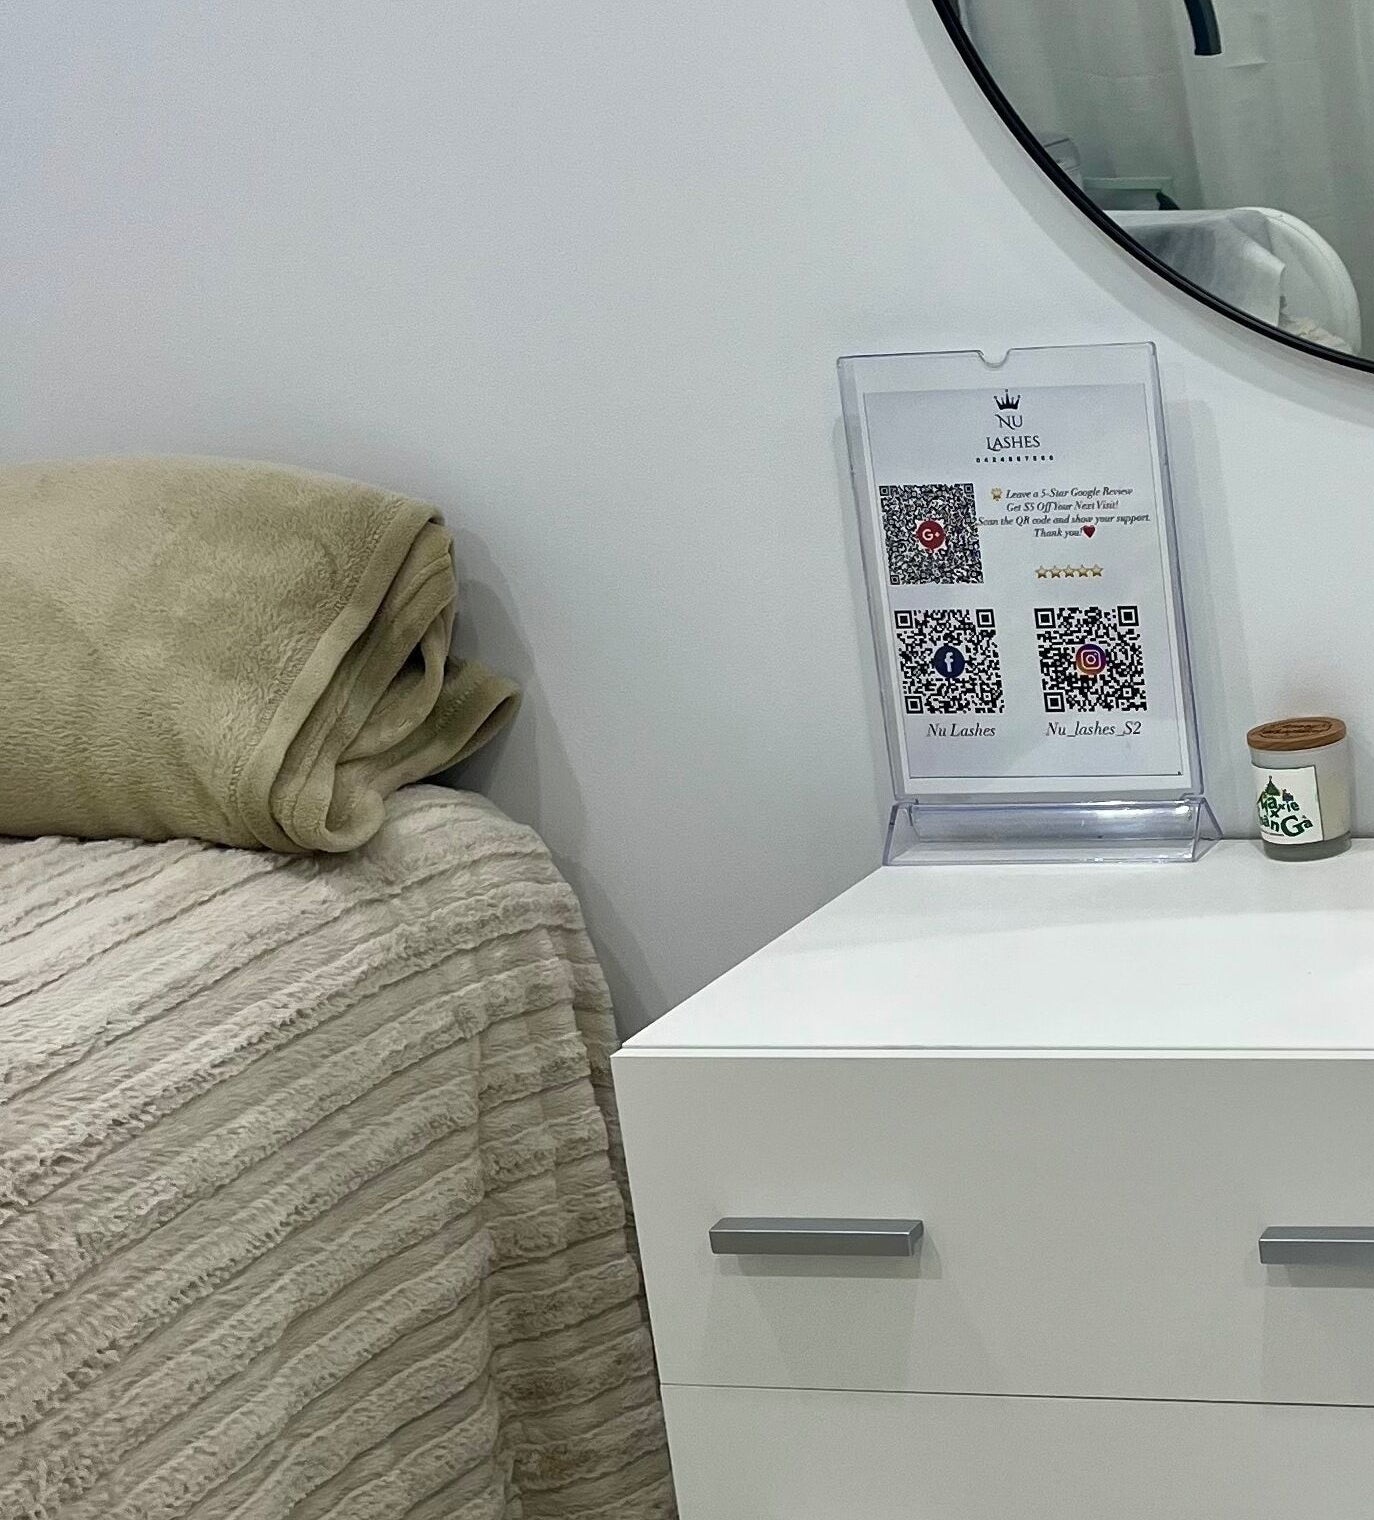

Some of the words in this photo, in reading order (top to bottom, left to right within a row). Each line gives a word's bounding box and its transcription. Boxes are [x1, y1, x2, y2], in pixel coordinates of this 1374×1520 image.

[994, 414, 1023, 430] NU
[986, 435, 1041, 451] LASHES
[1006, 489, 1031, 498] Leave
[1041, 488, 1069, 498] 5-Star
[1071, 487, 1100, 499] Google
[1103, 487, 1133, 496] Review
[1006, 502, 1021, 512] Get
[1074, 500, 1095, 510] Next
[1097, 500, 1119, 509] Visit!
[978, 516, 999, 526] Scan
[1001, 516, 1013, 526] the
[1015, 515, 1030, 527] QR
[1032, 515, 1051, 525] code
[1053, 514, 1070, 524] and
[1071, 514, 1093, 523] show
[1095, 516, 1114, 525] your
[1034, 528, 1063, 538] Thank
[926, 723, 946, 737] Nu
[950, 722, 996, 737] Lashes
